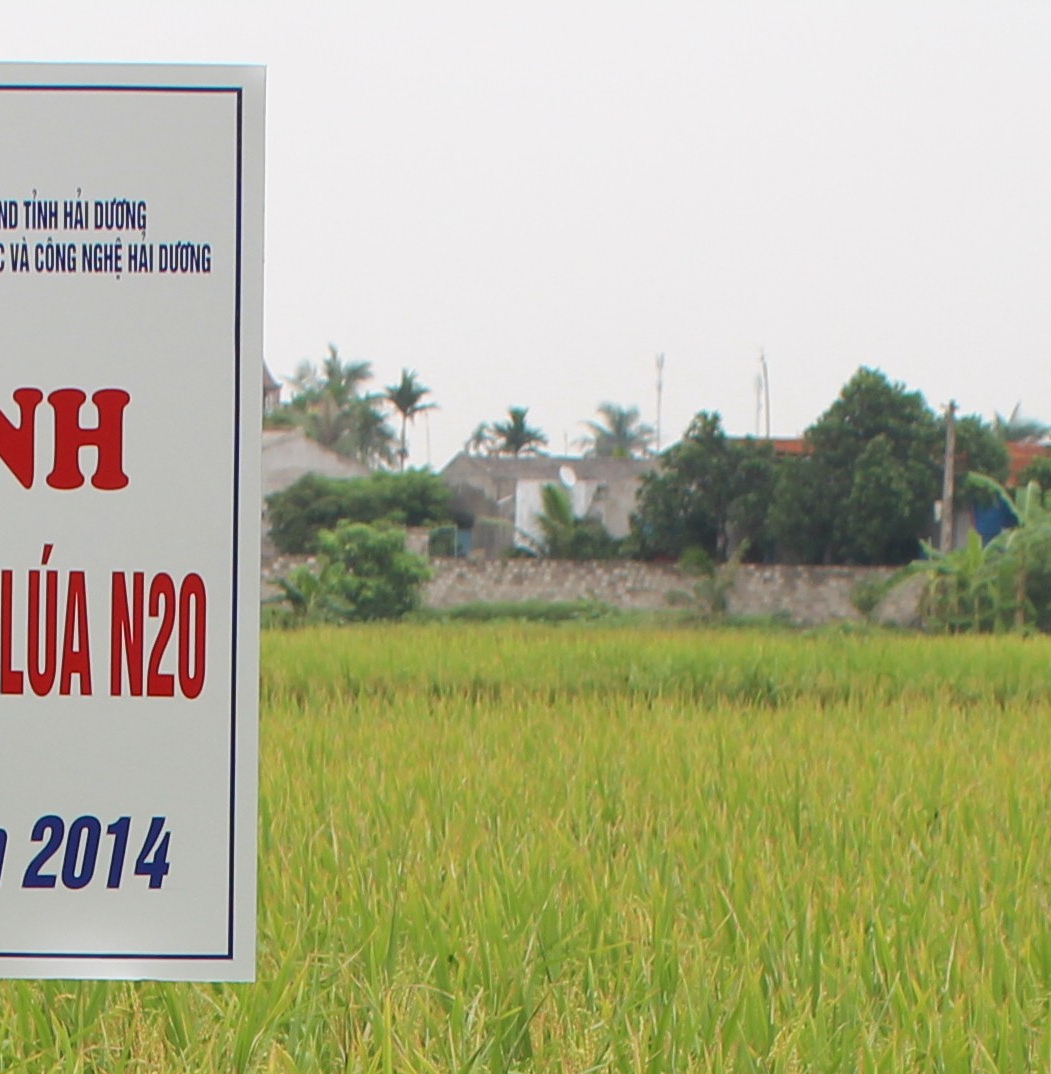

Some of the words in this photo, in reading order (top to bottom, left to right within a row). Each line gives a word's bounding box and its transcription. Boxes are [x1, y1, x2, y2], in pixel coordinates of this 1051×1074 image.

[23, 189, 58, 230] TỈNH
[63, 187, 89, 230] HẢI
[94, 198, 147, 231] DƯƠNG
[10, 236, 30, 273] VÀ
[34, 237, 77, 273] CÔNG
[81, 237, 123, 280] NGHỆ
[127, 231, 154, 273] HẢI
[158, 241, 211, 274] DƯƠNG
[0, 543, 93, 697] LÚA
[109, 571, 207, 699] N20
[21, 815, 172, 890] 2014
